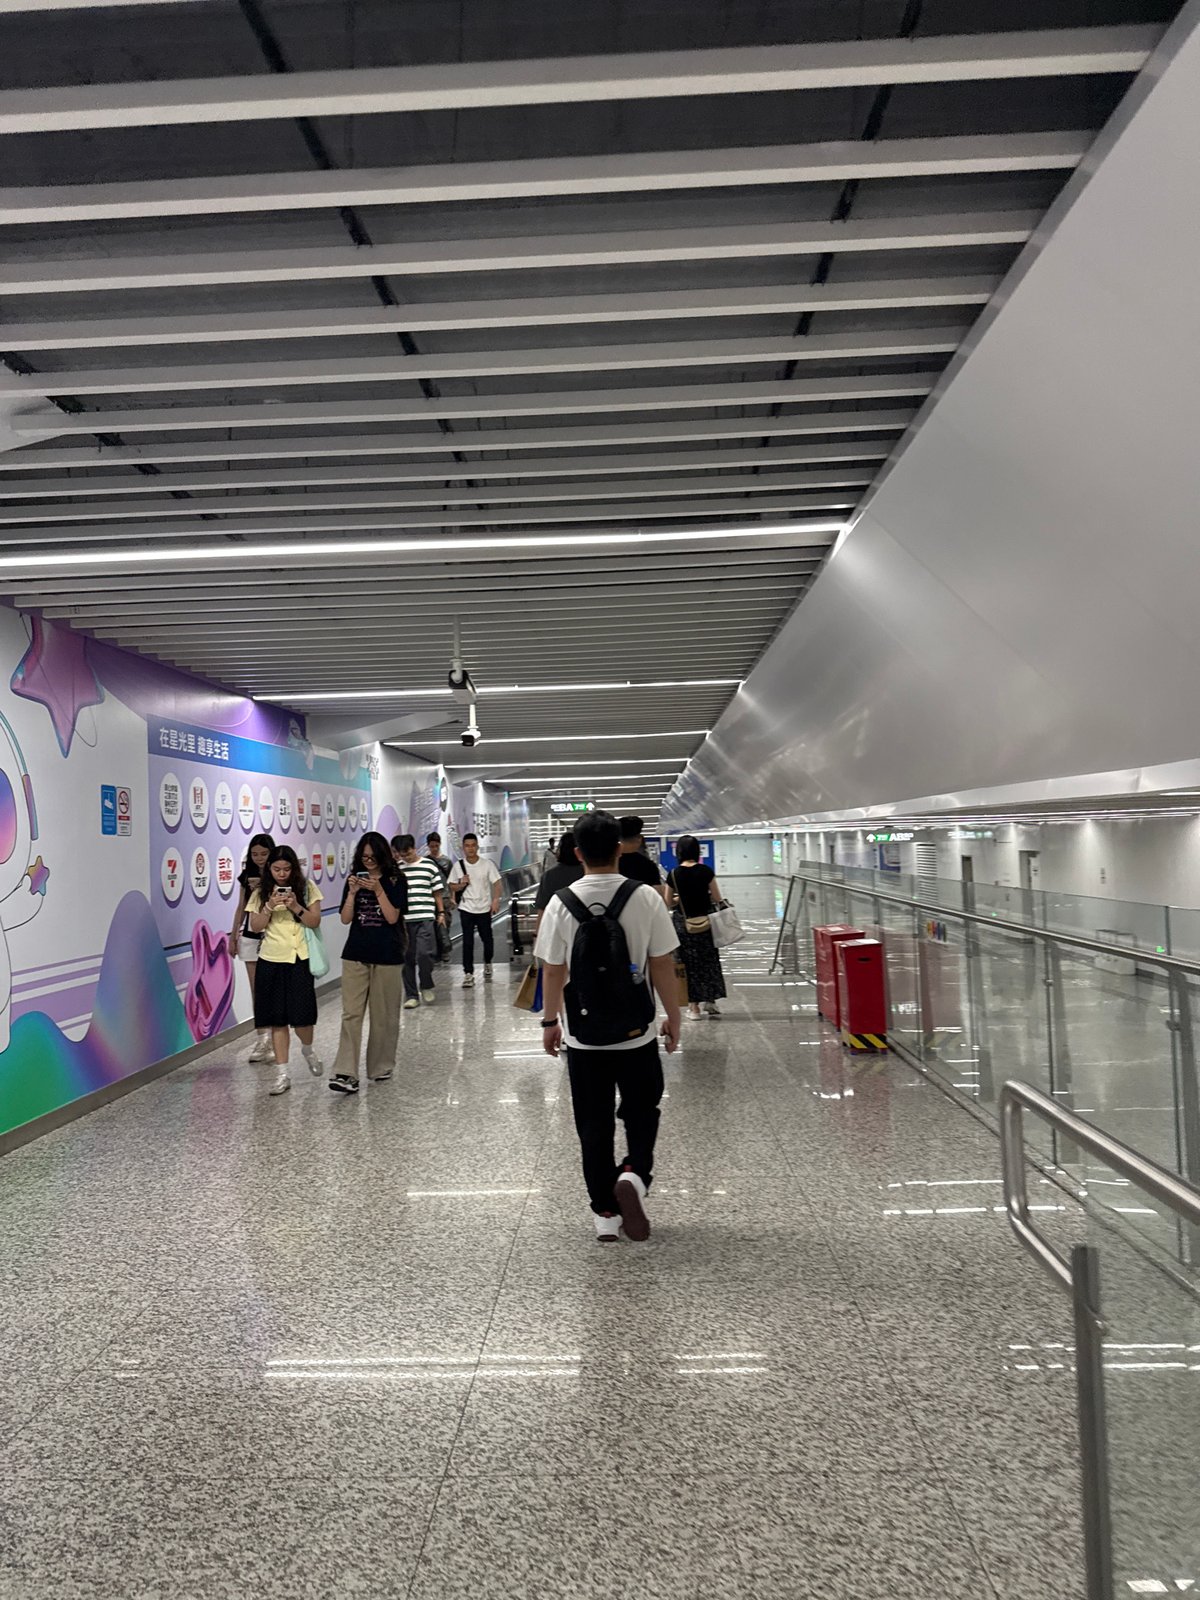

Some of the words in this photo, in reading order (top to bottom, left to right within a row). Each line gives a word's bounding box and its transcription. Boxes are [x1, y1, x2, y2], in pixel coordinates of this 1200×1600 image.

[159, 727, 196, 754] 在星光里
[197, 736, 229, 761] 趣享生活
